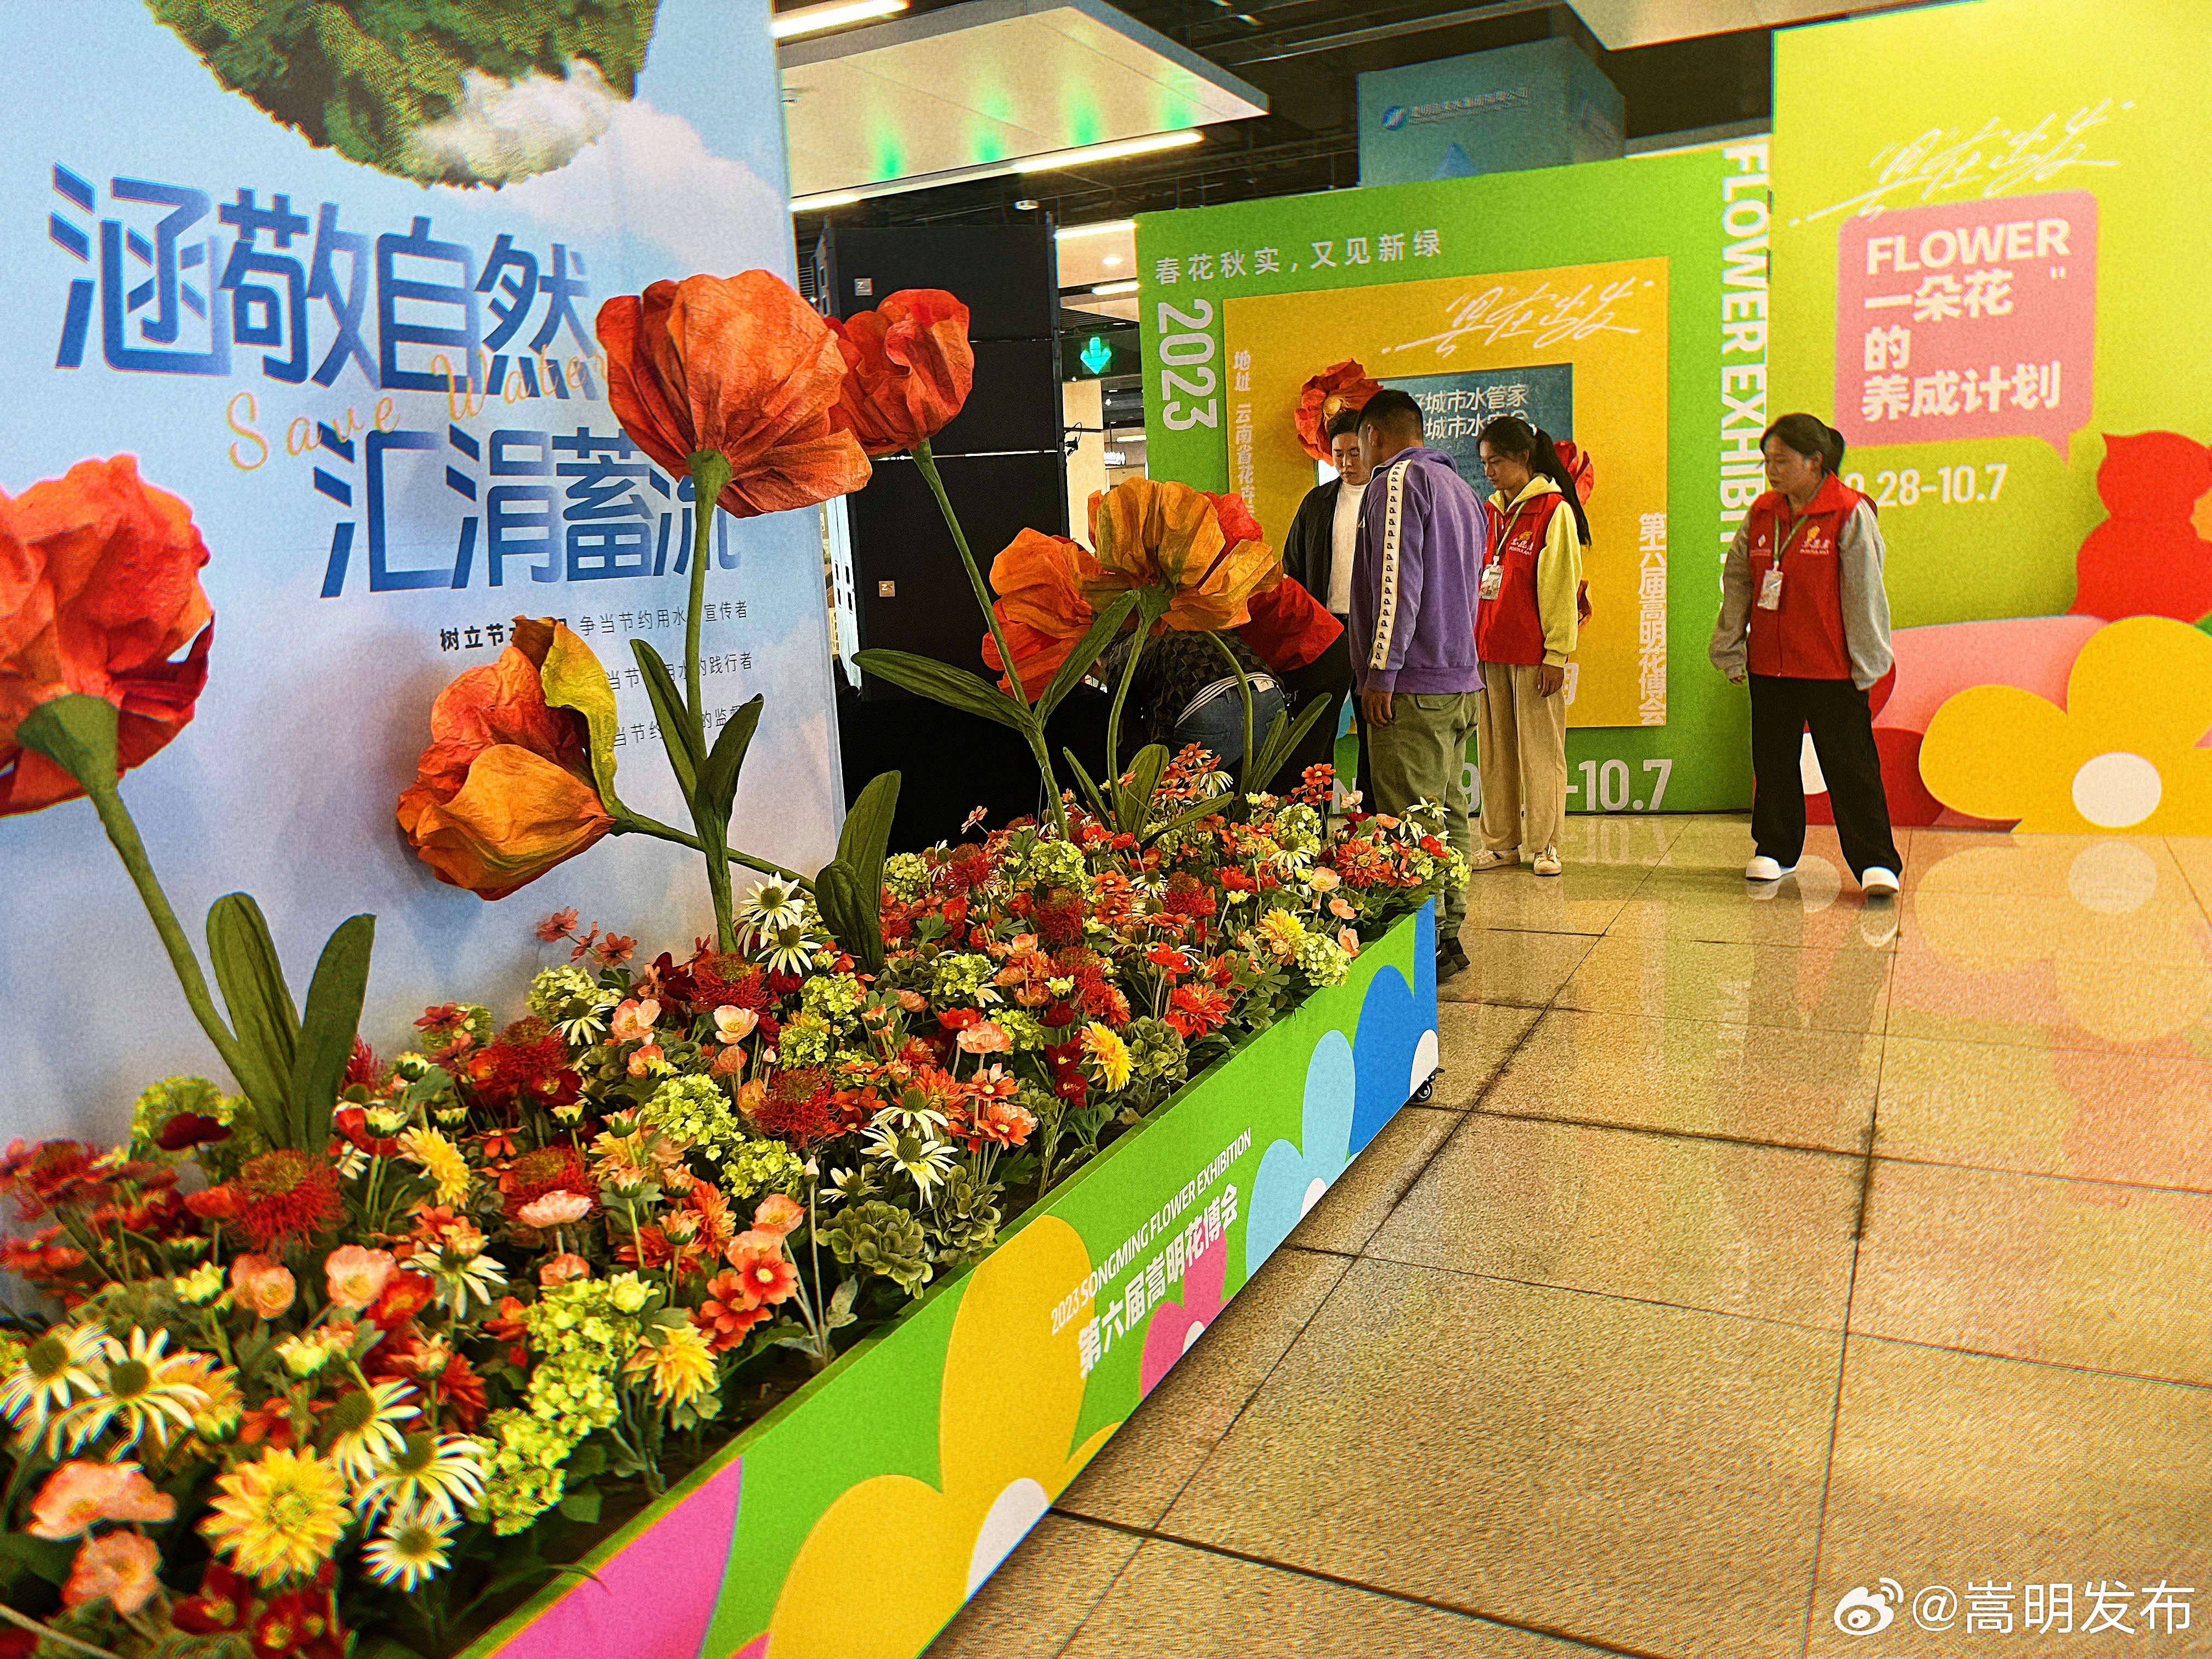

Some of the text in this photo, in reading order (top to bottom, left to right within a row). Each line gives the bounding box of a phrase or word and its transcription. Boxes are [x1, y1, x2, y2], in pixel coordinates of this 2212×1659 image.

[49, 159, 599, 402] 涵敬自然
[1721, 141, 1769, 354] FLOWER
[1865, 268, 2015, 322] 一朵花
[1866, 217, 2071, 275] FLOWER
[1158, 298, 1217, 431] 2023
[1233, 351, 1251, 392] 地址
[1861, 360, 2061, 422] 养成计划
[1864, 324, 1911, 372] 的
[226, 391, 399, 471] Save
[312, 421, 741, 598] 汇涓蓄流
[440, 600, 747, 652] 树立节 争当节约用水宣传者
[1639, 512, 1666, 725] 第六届嵩明花博会
[1051, 1127, 1251, 1335] 2023 SONGMING FLOWER EXHIBITION
[1079, 1183, 1238, 1379] 第六届嵩明花博会
